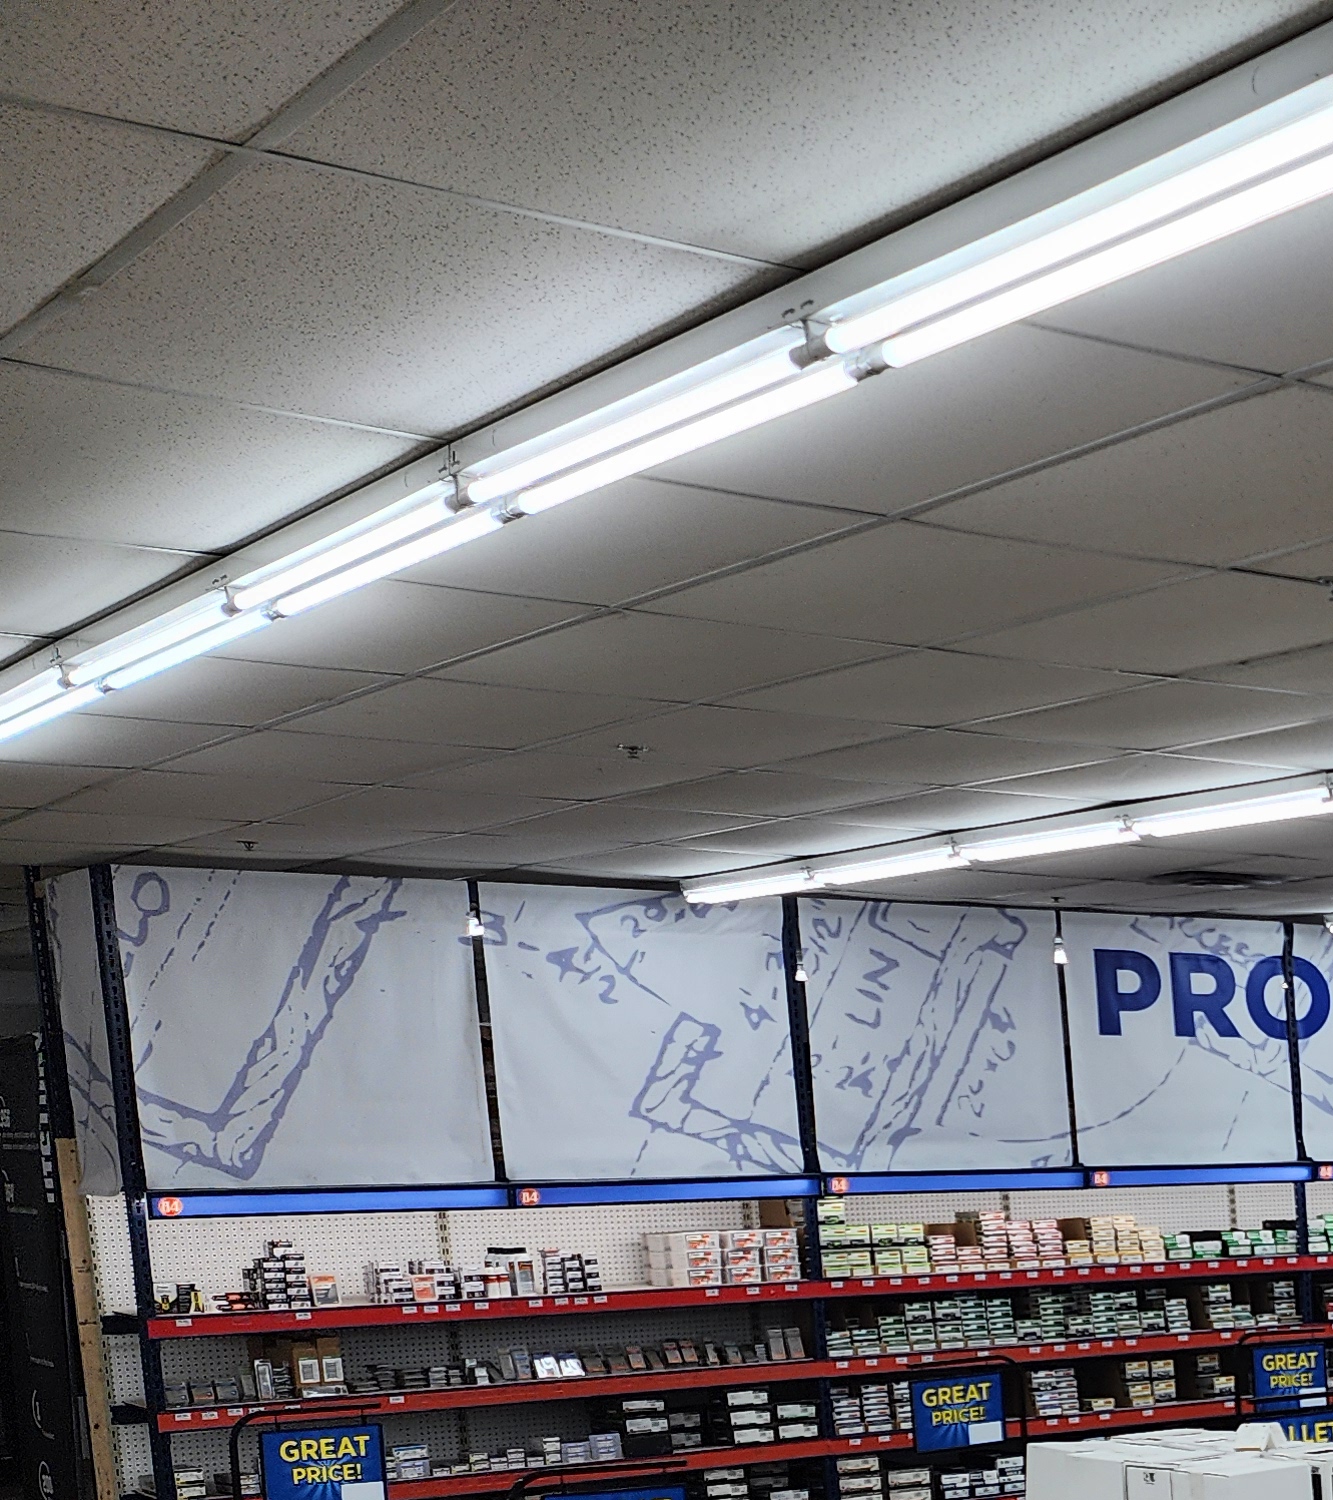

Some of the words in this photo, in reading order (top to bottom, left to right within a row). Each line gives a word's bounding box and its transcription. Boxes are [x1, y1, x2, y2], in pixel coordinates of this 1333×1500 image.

[1262, 1352, 1318, 1371] GREAT
[1270, 1373, 1313, 1388] PRICE!
[921, 1382, 992, 1408] GREAT
[932, 1405, 986, 1427] PRICE!
[279, 1435, 370, 1461] GREAT
[292, 1463, 363, 1485] PRICE!
